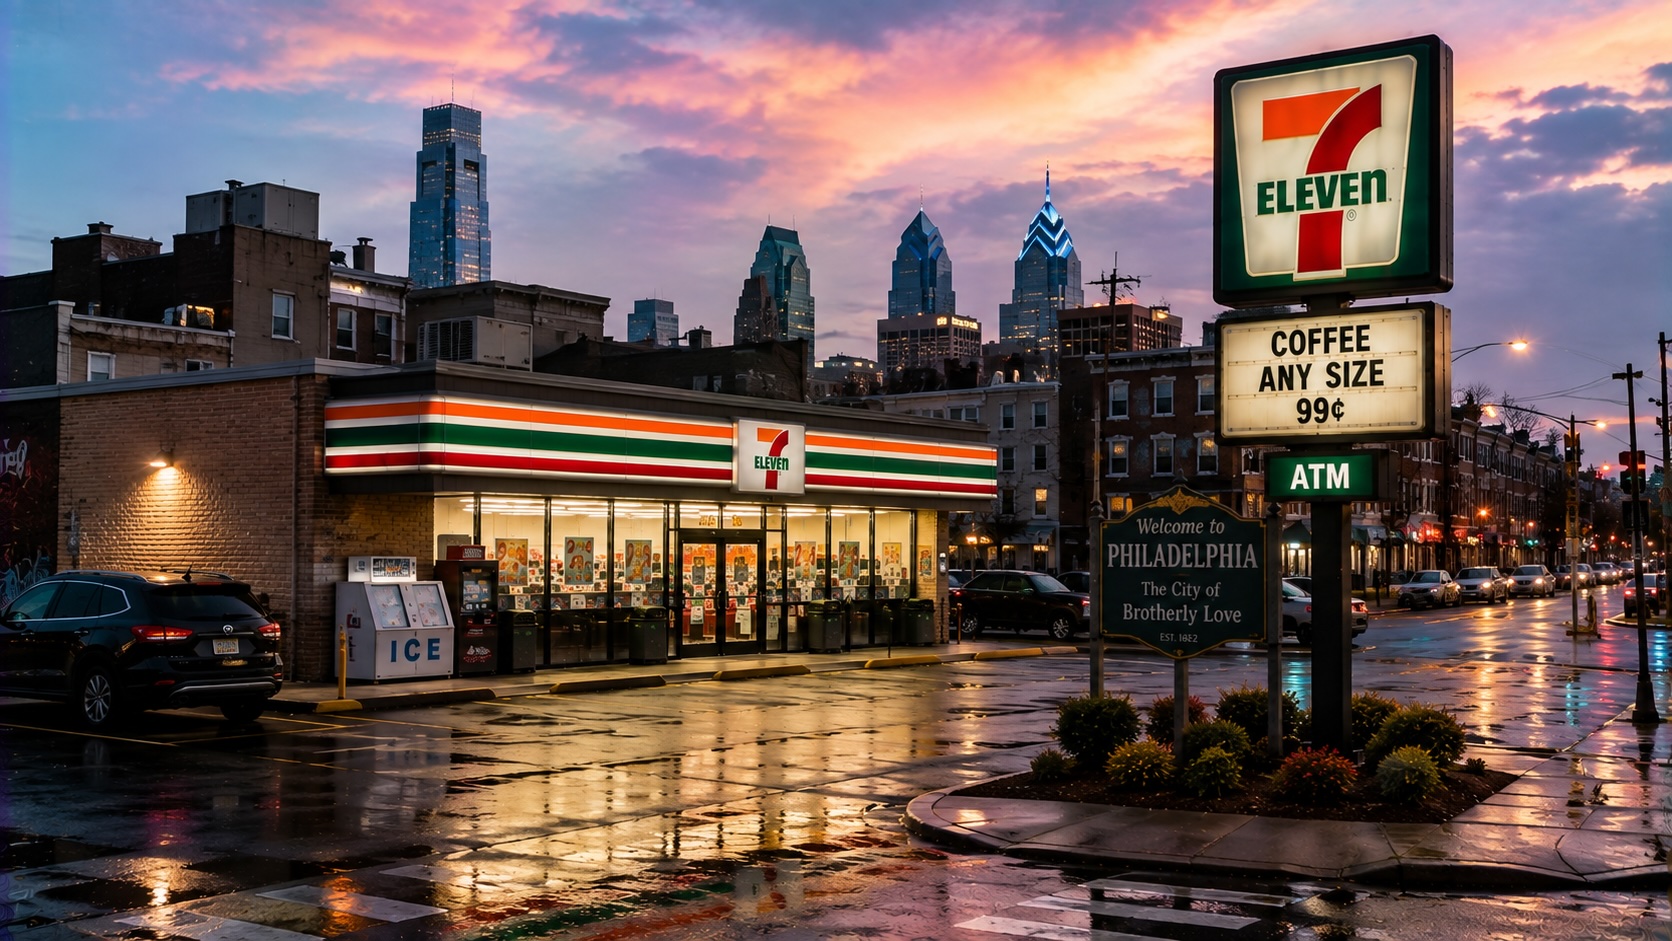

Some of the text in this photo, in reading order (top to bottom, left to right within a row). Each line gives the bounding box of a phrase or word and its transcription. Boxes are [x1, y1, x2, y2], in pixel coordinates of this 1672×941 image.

[1263, 84, 1382, 273] 7
[1271, 324, 1370, 357] COFFEE
[1259, 359, 1384, 392] ANY SIZE
[1296, 397, 1345, 424] 99¢
[757, 427, 789, 490] 7
[1290, 463, 1350, 490] ATM
[1136, 518, 1225, 535] Welcome to
[1107, 543, 1259, 569] PHILADELPHIA
[1141, 581, 1221, 601] The City of
[1123, 603, 1242, 626] Brotherly Love
[1160, 632, 1177, 642] EST.
[390, 638, 441, 663] ICE
